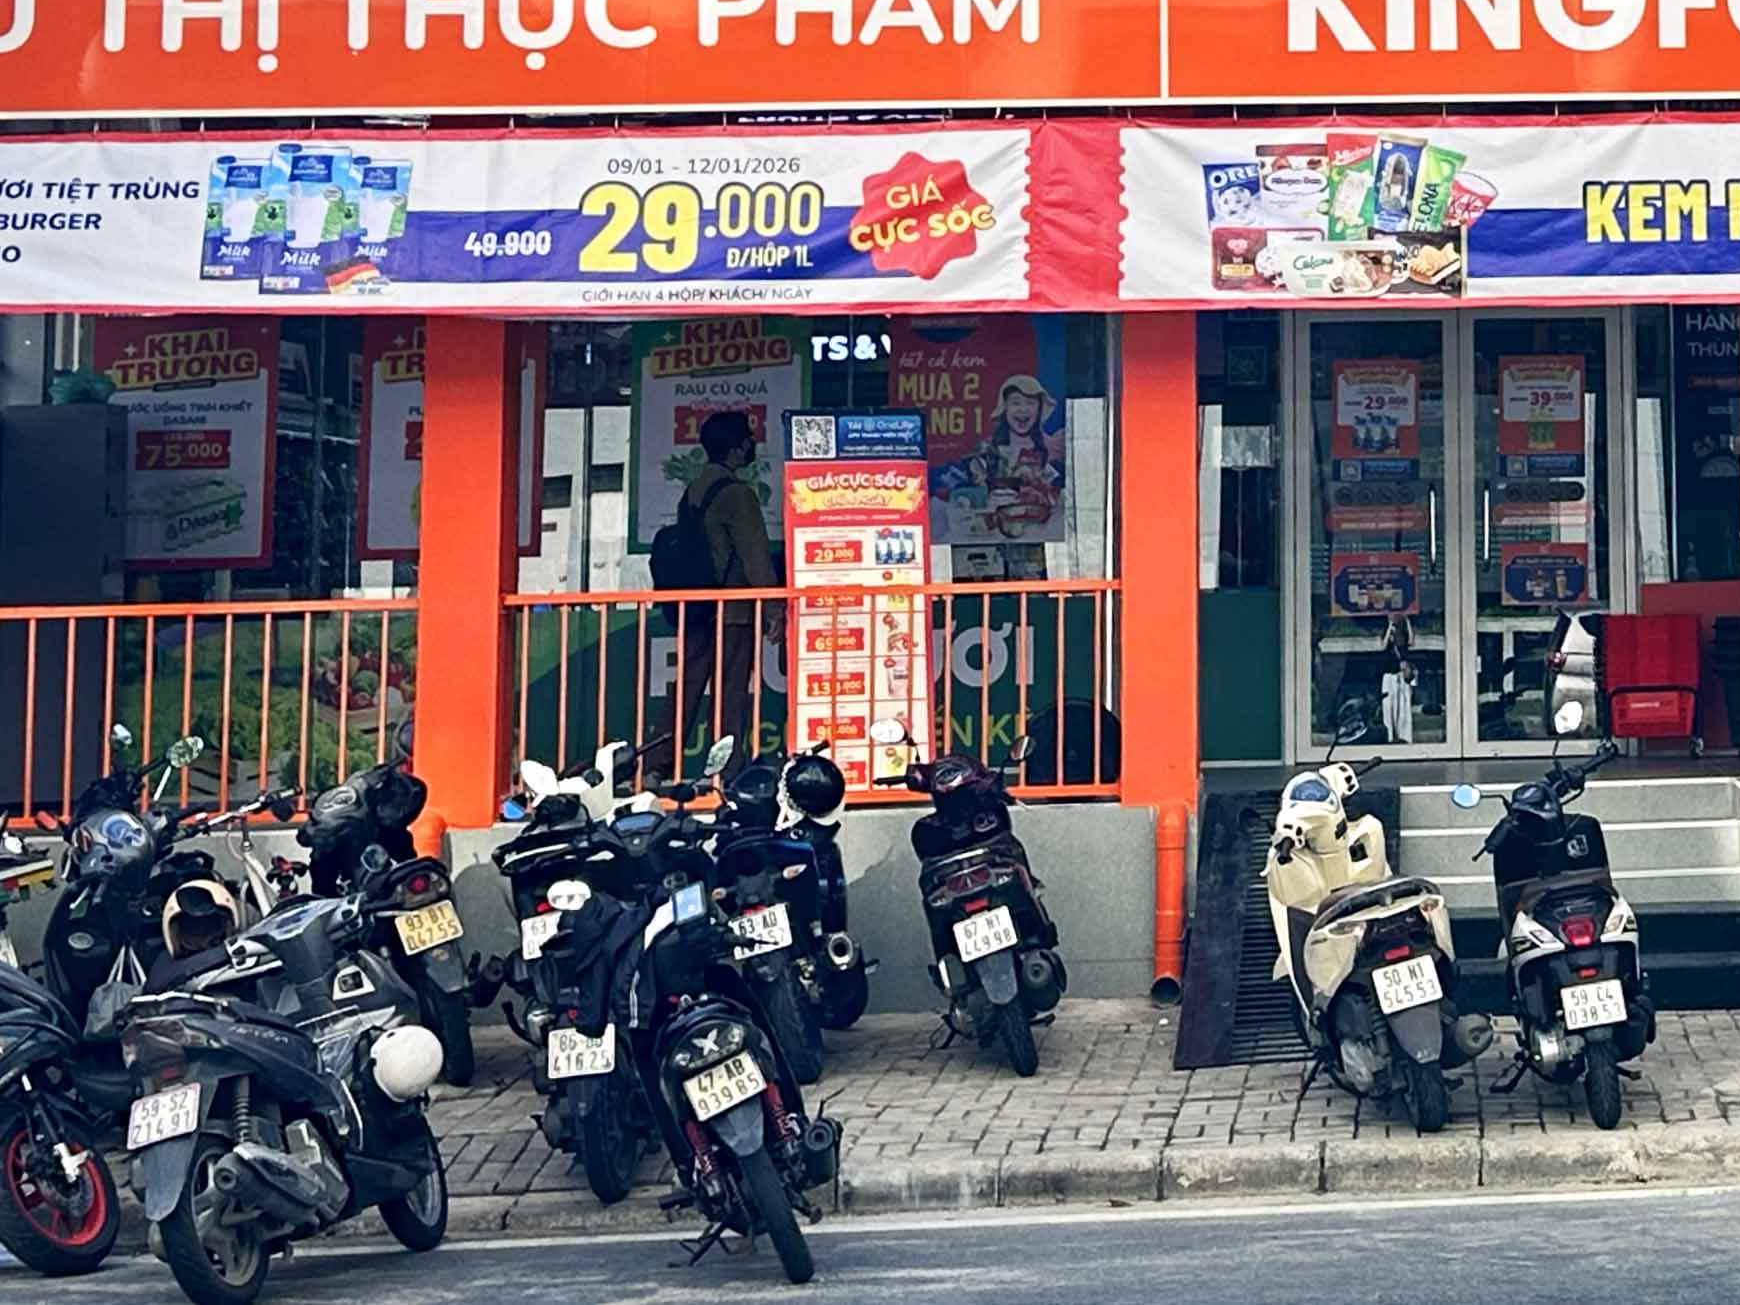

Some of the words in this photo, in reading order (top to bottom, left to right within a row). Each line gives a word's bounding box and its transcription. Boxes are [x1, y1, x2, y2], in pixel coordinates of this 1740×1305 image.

[607, 159, 665, 176] 09/01
[686, 158, 801, 176] 12/01/2026
[43, 178, 100, 203] TIỆT
[108, 176, 200, 201] TRÙNG
[886, 174, 944, 210] GIÁ
[578, 181, 825, 274] 29.000
[849, 215, 921, 254] CỰC
[928, 198, 997, 235] SỐC
[1583, 179, 1709, 245] KEM
[726, 242, 790, 274] Đ/HỘP
[795, 247, 814, 268] 1L
[146, 330, 226, 359] KHAI
[898, 372, 951, 402] MUA
[962, 376, 981, 401] 2
